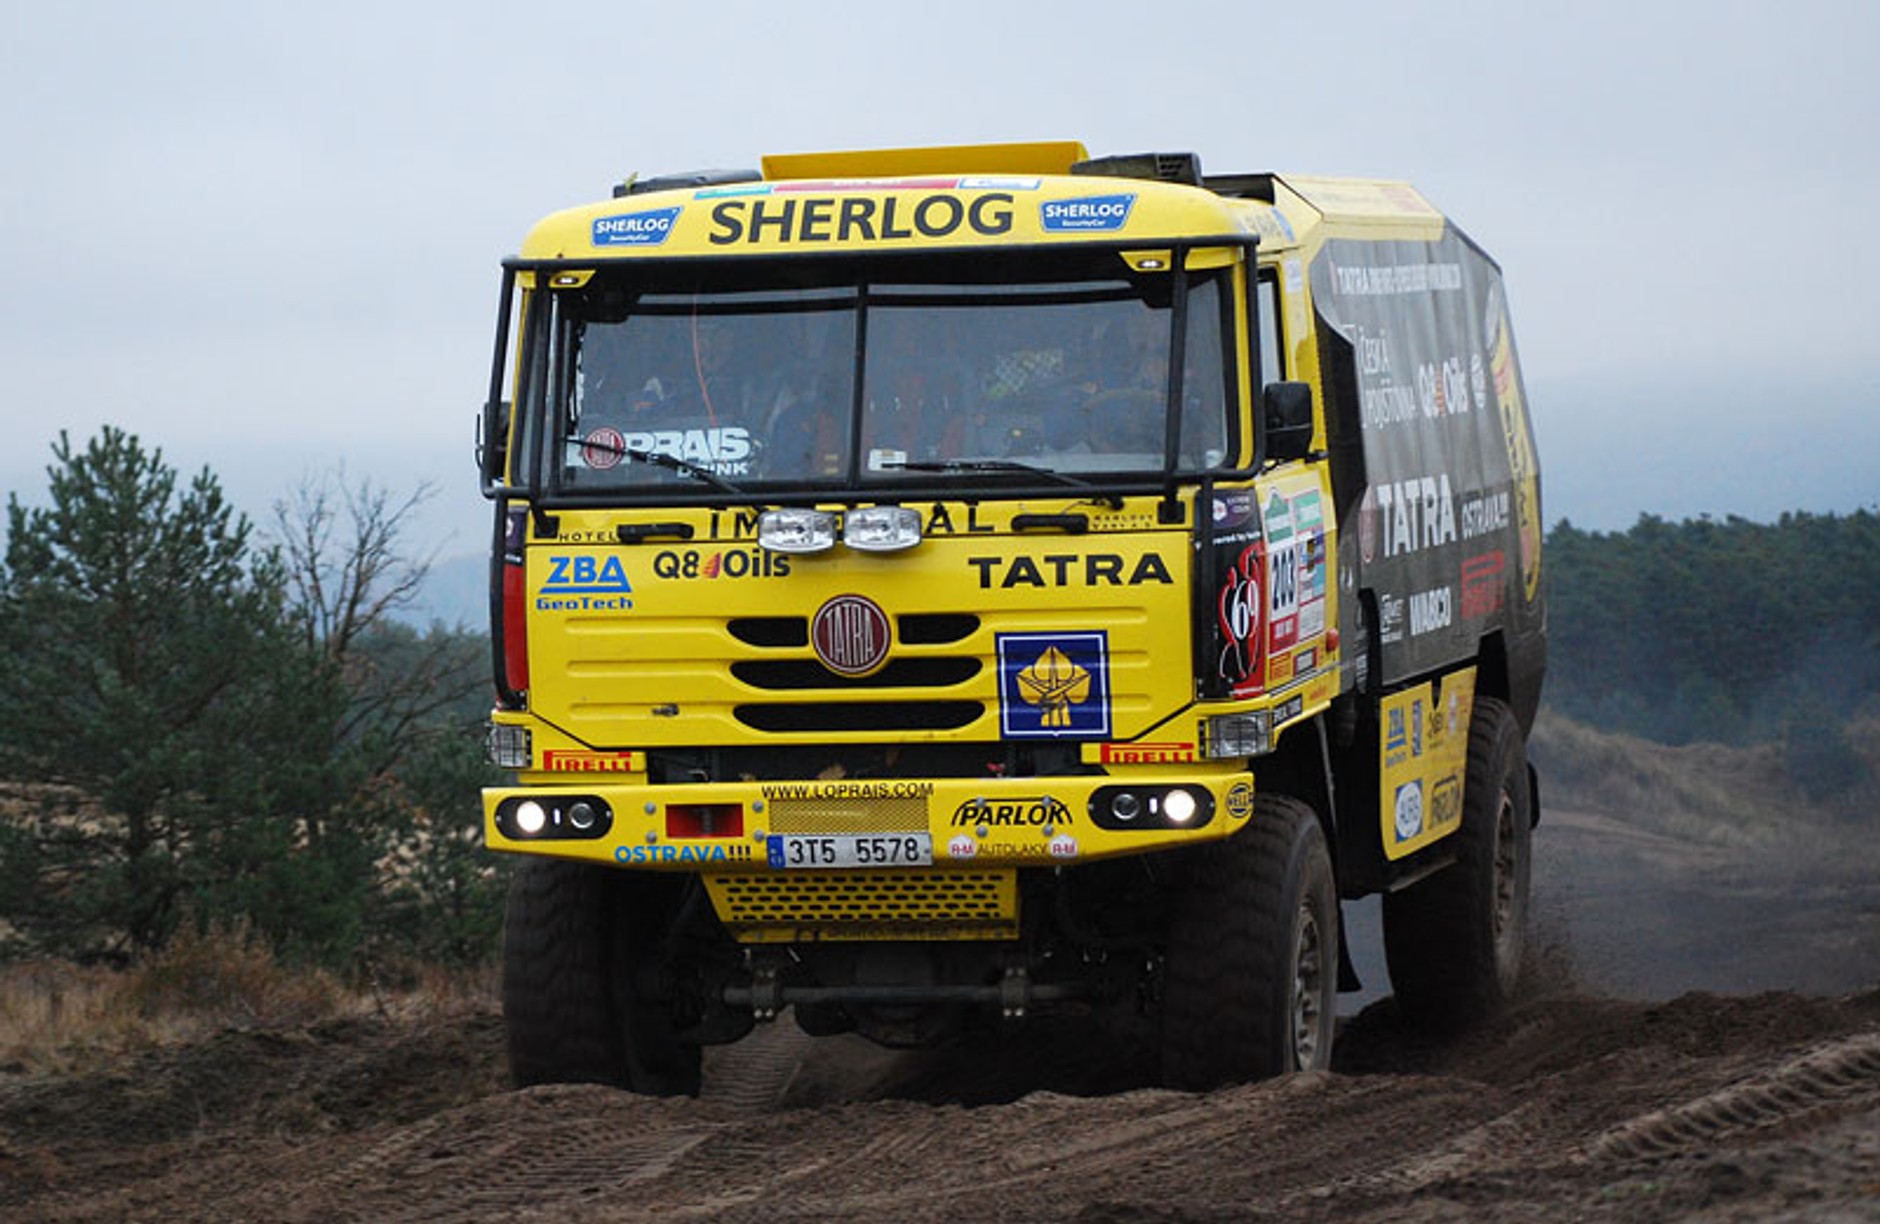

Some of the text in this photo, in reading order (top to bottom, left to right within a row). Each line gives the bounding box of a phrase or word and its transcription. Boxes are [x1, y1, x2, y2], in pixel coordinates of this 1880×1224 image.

[709, 193, 1014, 245] SHERLOG
[1044, 203, 1126, 218] SHERLOG
[595, 217, 669, 235] SHERLOG
[1376, 473, 1457, 558] TATRA
[558, 531, 618, 543] HOTEL
[545, 556, 631, 586] ZBA
[653, 549, 791, 579] Q8 Oils
[968, 553, 1174, 589] TATRA
[1271, 547, 1295, 610] 203
[536, 597, 633, 610] GeoTech
[824, 602, 875, 667] TATRA
[543, 751, 631, 772] PIRELLI
[1101, 742, 1194, 764] PIRELLI
[761, 782, 934, 800] WWW.LOPRAIS.COM
[959, 803, 1069, 826] PARLOK
[614, 845, 751, 864] OSTRAVA!!!
[789, 839, 836, 865] 3T5
[855, 837, 920, 863] 5578
